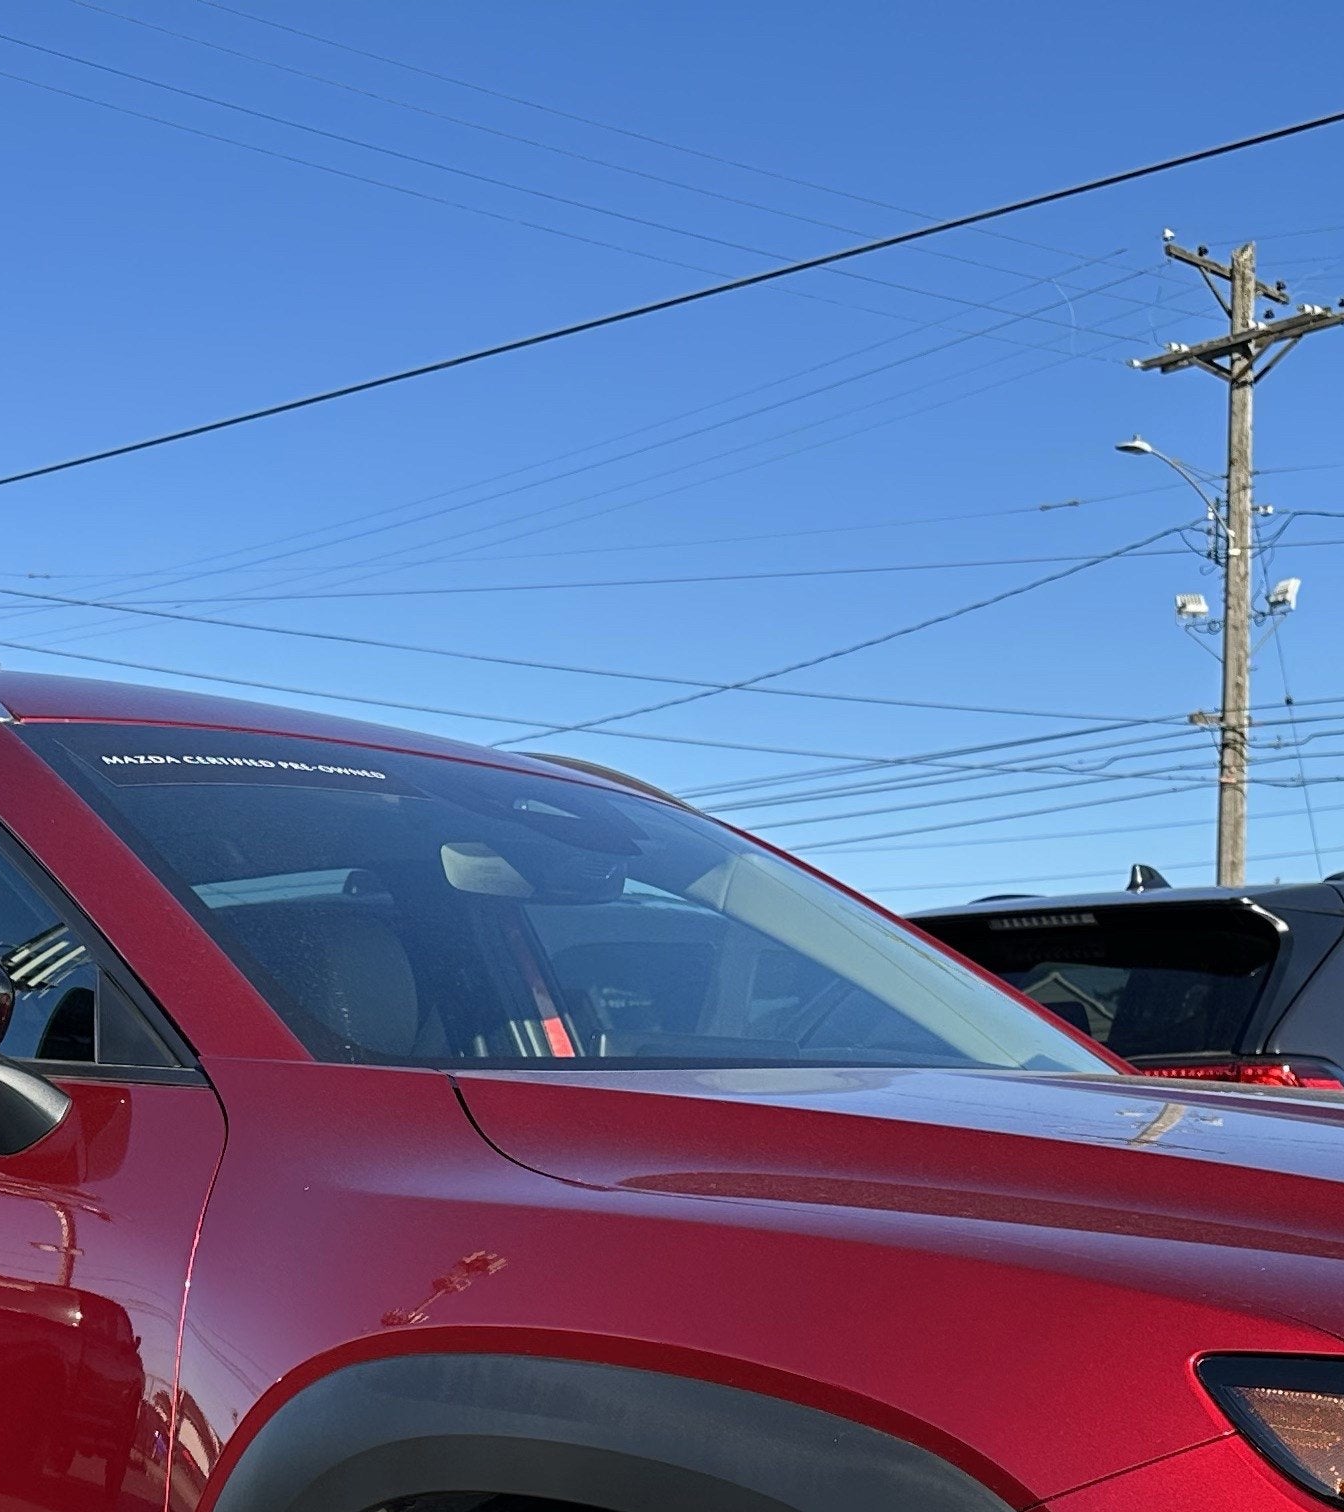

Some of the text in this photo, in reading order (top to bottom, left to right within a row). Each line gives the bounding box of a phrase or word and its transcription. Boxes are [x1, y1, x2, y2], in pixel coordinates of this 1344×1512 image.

[102, 755, 386, 780] MAZDA CERTIFIED PRE-OWNED
